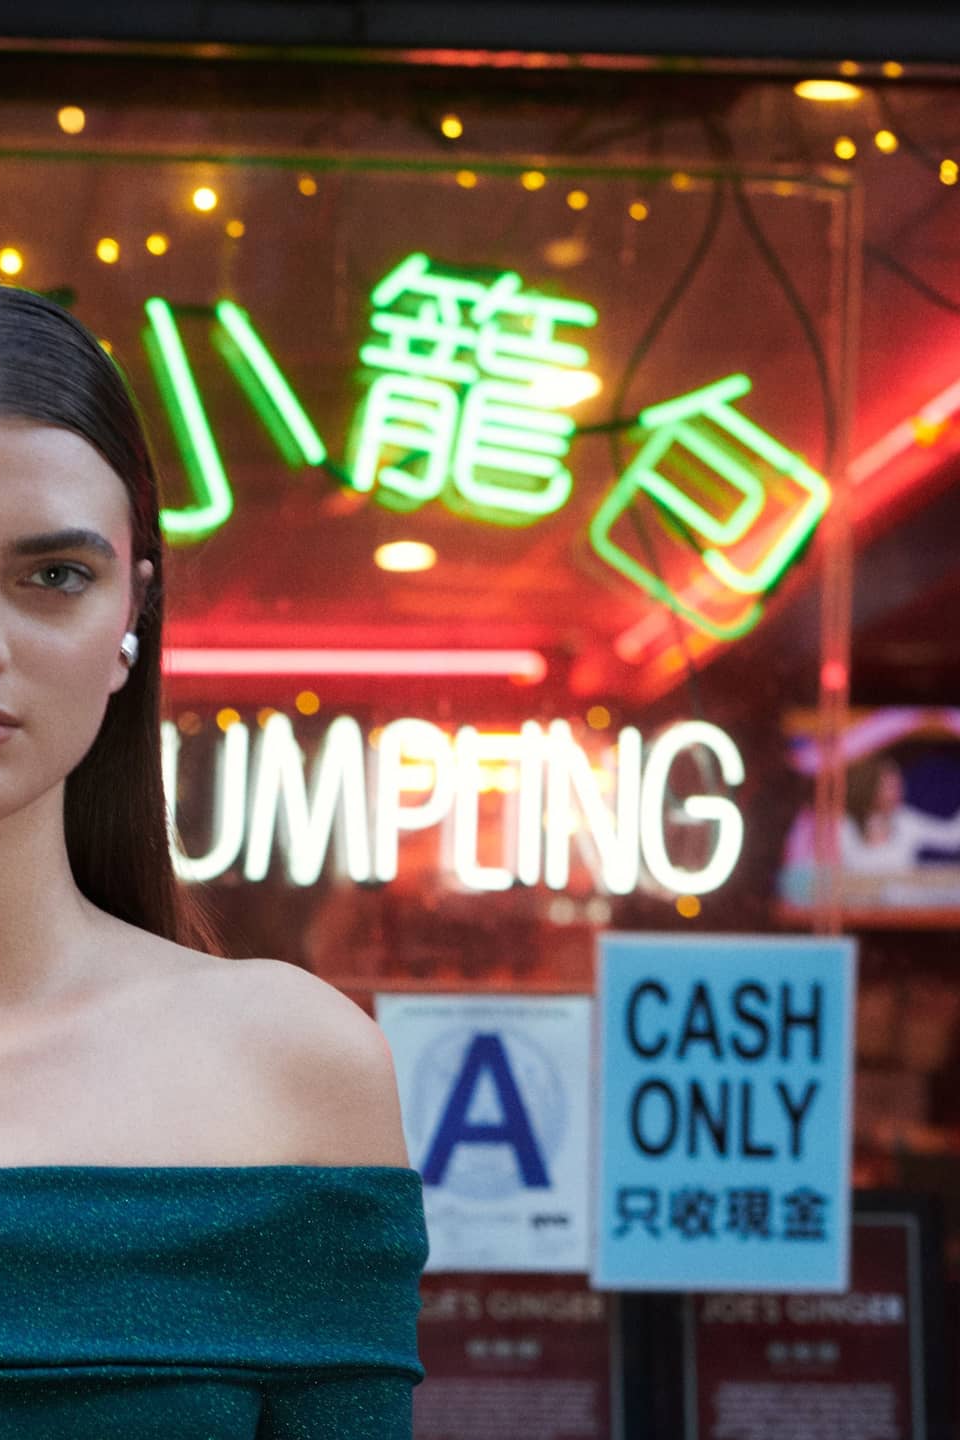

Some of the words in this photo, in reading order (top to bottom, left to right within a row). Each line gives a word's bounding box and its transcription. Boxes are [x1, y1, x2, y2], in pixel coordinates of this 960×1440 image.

[159, 713, 745, 894] UMPLING
[624, 978, 825, 1063] CASH
[420, 1033, 553, 1189] A
[630, 1078, 821, 1162] ONLY
[613, 1184, 828, 1243] 只收現金
